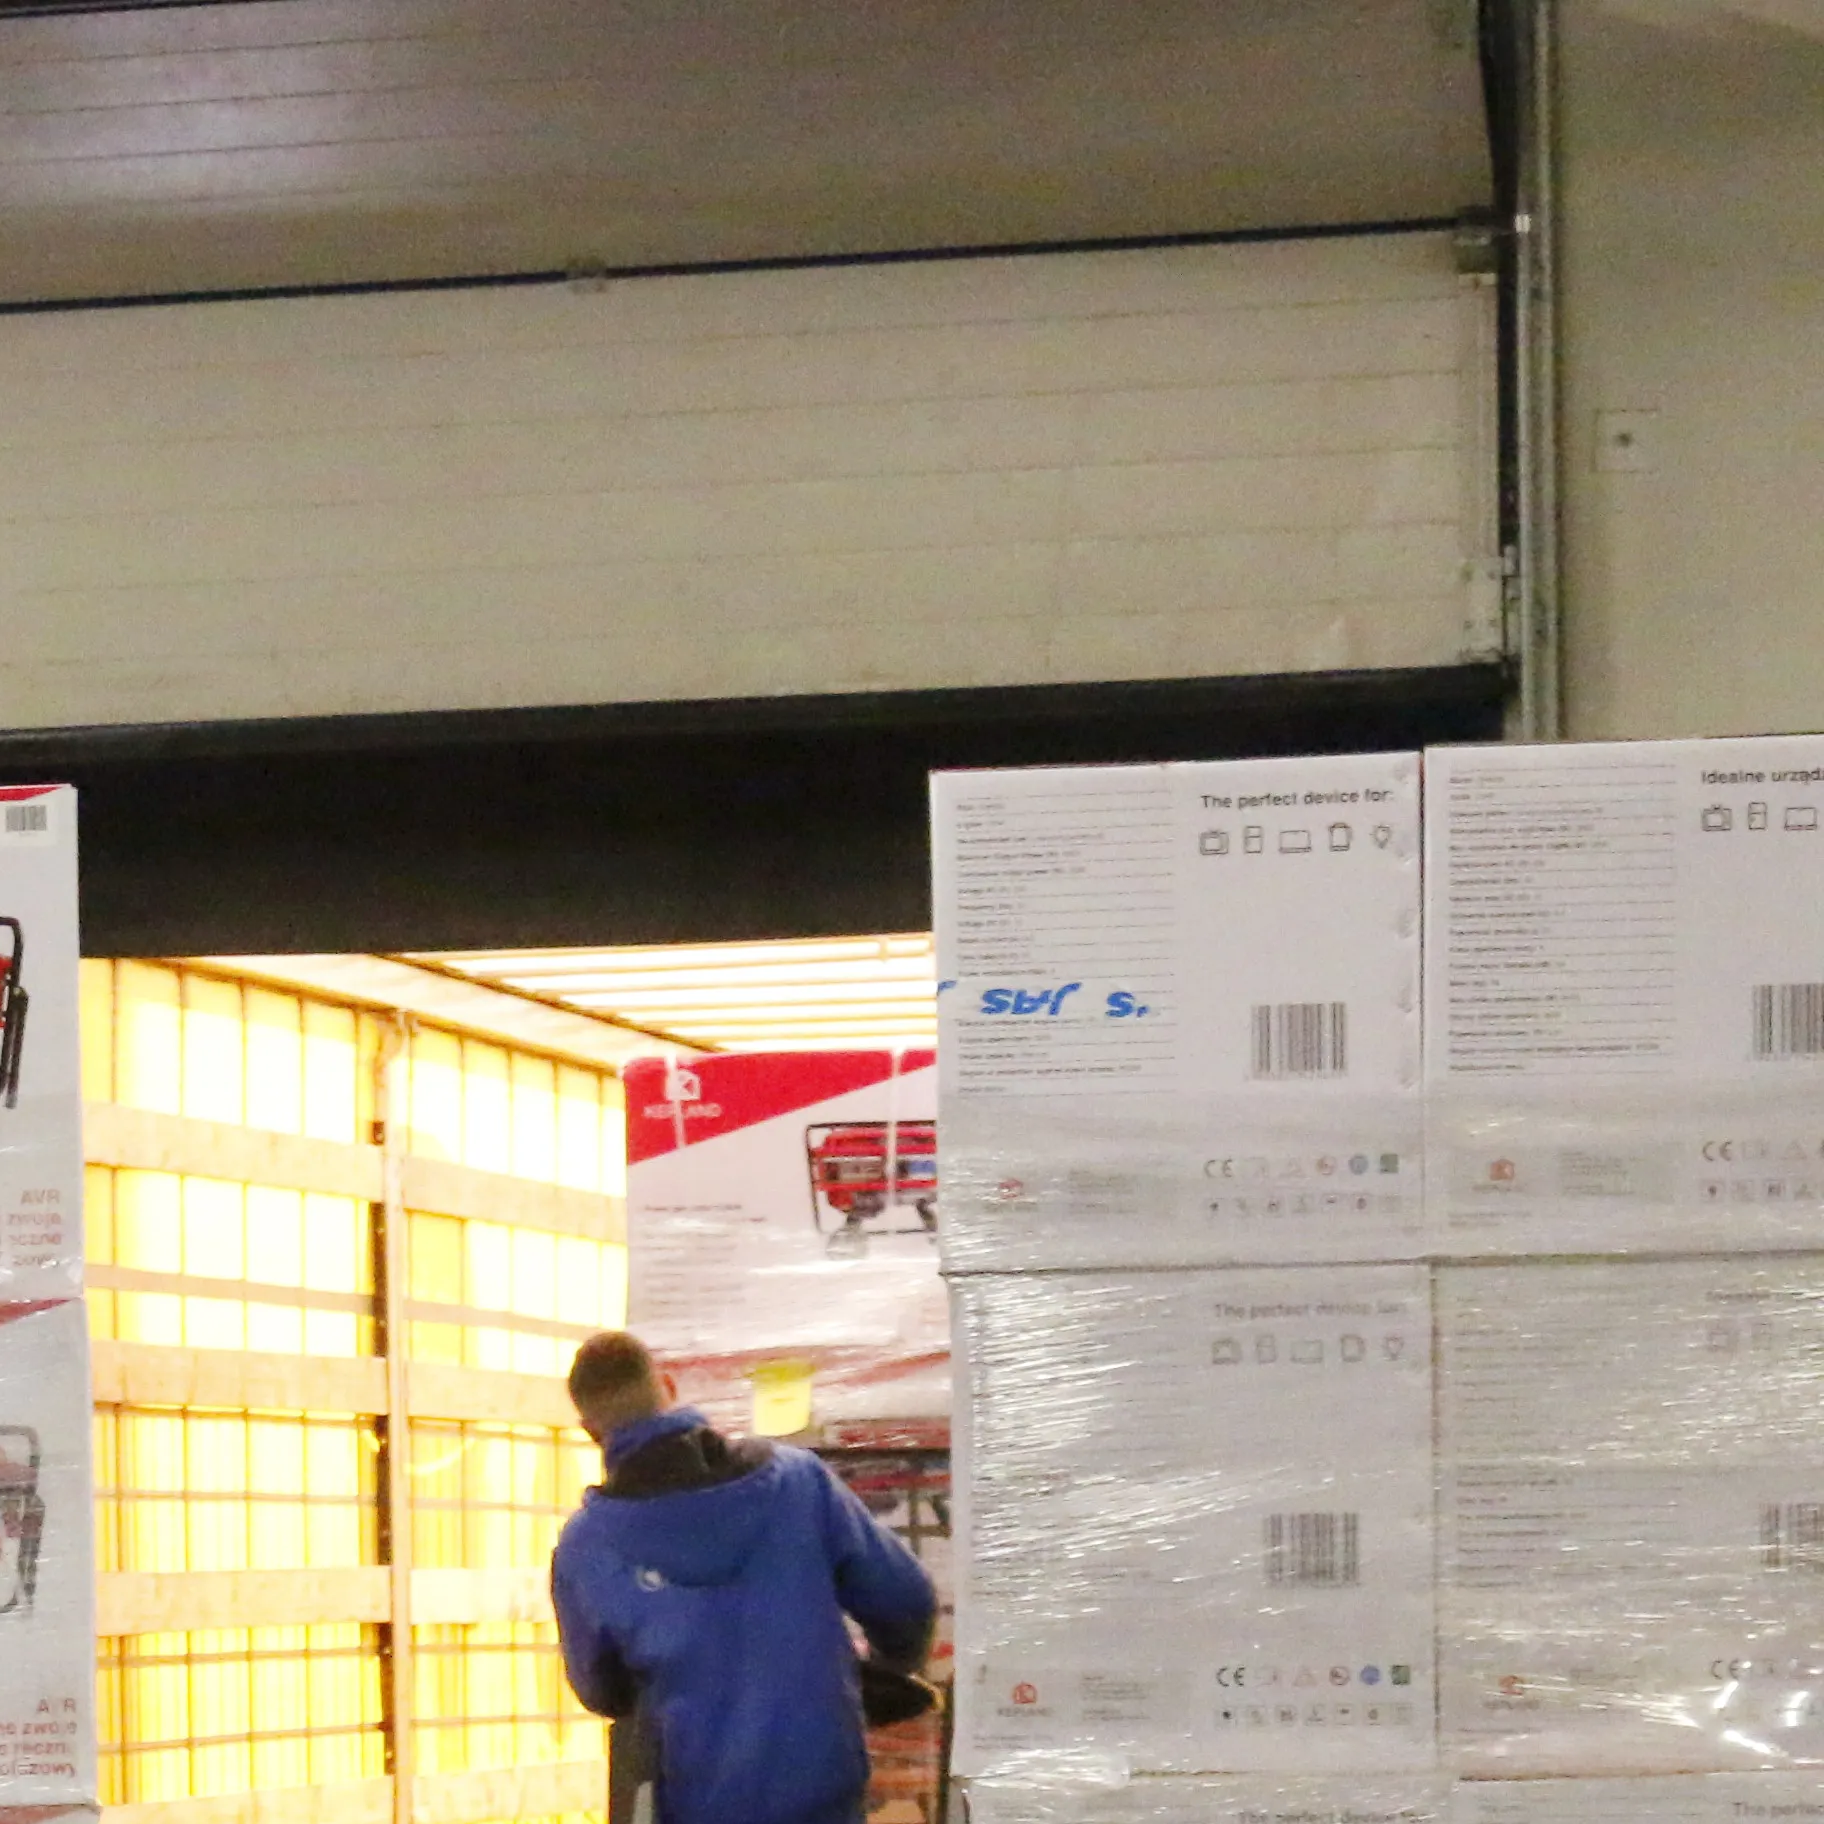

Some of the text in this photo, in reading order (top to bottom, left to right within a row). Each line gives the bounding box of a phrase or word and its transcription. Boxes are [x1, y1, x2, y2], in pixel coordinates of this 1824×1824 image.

[1702, 767, 1824, 786] Idealne urząd
[1200, 794, 1232, 808] The
[1238, 792, 1297, 810] perfect
[1303, 789, 1359, 805] device
